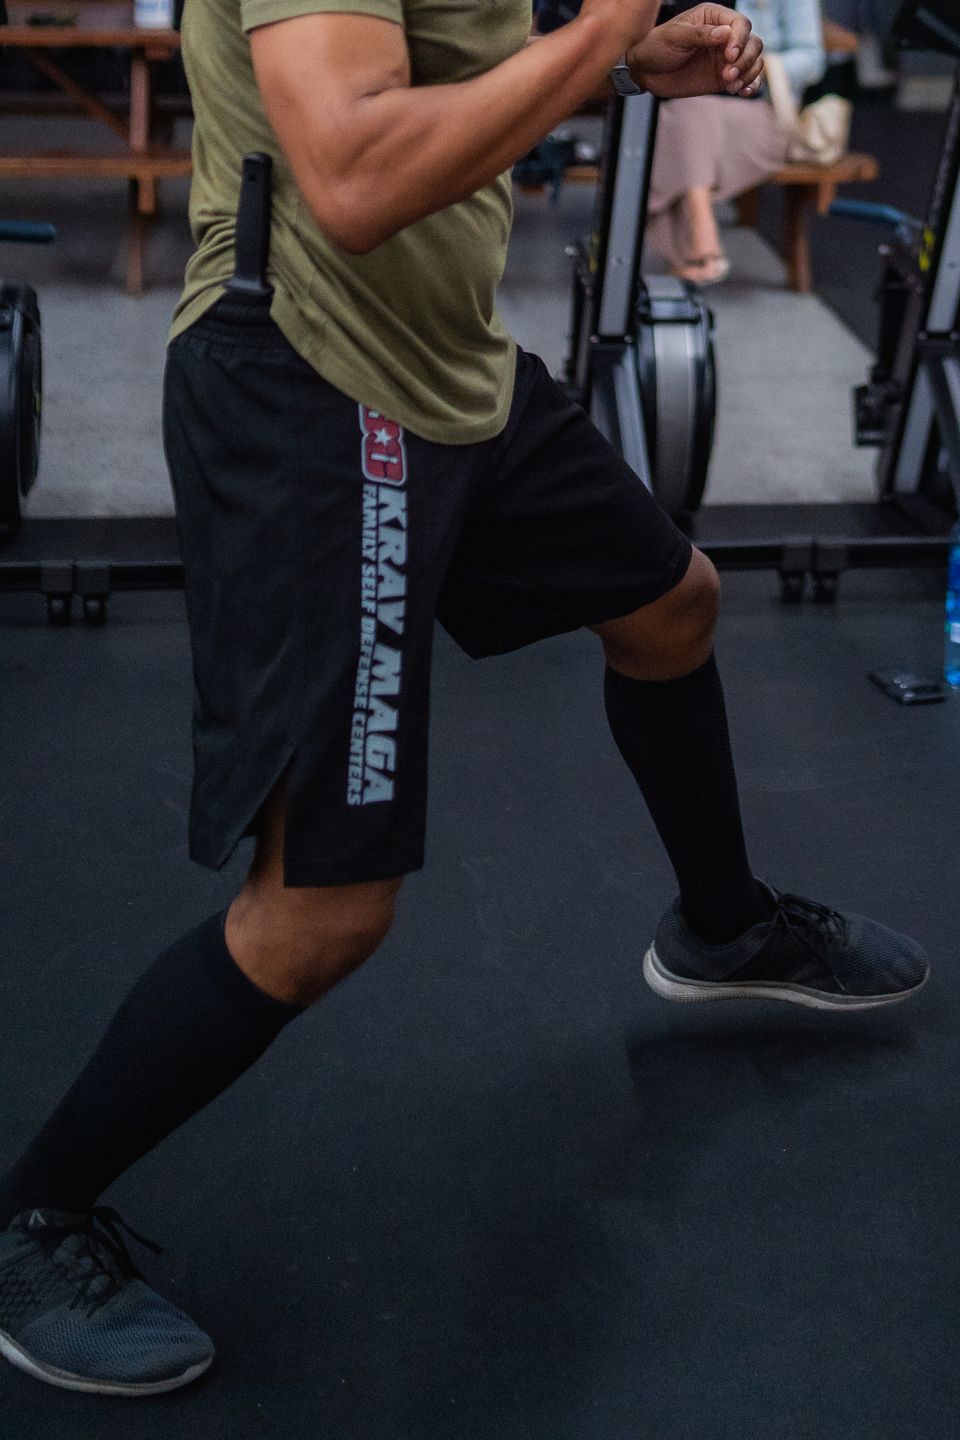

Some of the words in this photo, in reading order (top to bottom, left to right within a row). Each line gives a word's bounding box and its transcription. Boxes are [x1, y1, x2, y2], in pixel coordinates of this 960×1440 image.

[361, 484, 378, 561] FAMILY
[376, 486, 408, 635] KRAV
[361, 562, 377, 614] SELF
[354, 615, 377, 710] DEFENSE
[347, 712, 368, 807] CENTERS
[365, 640, 404, 805] MAGA
